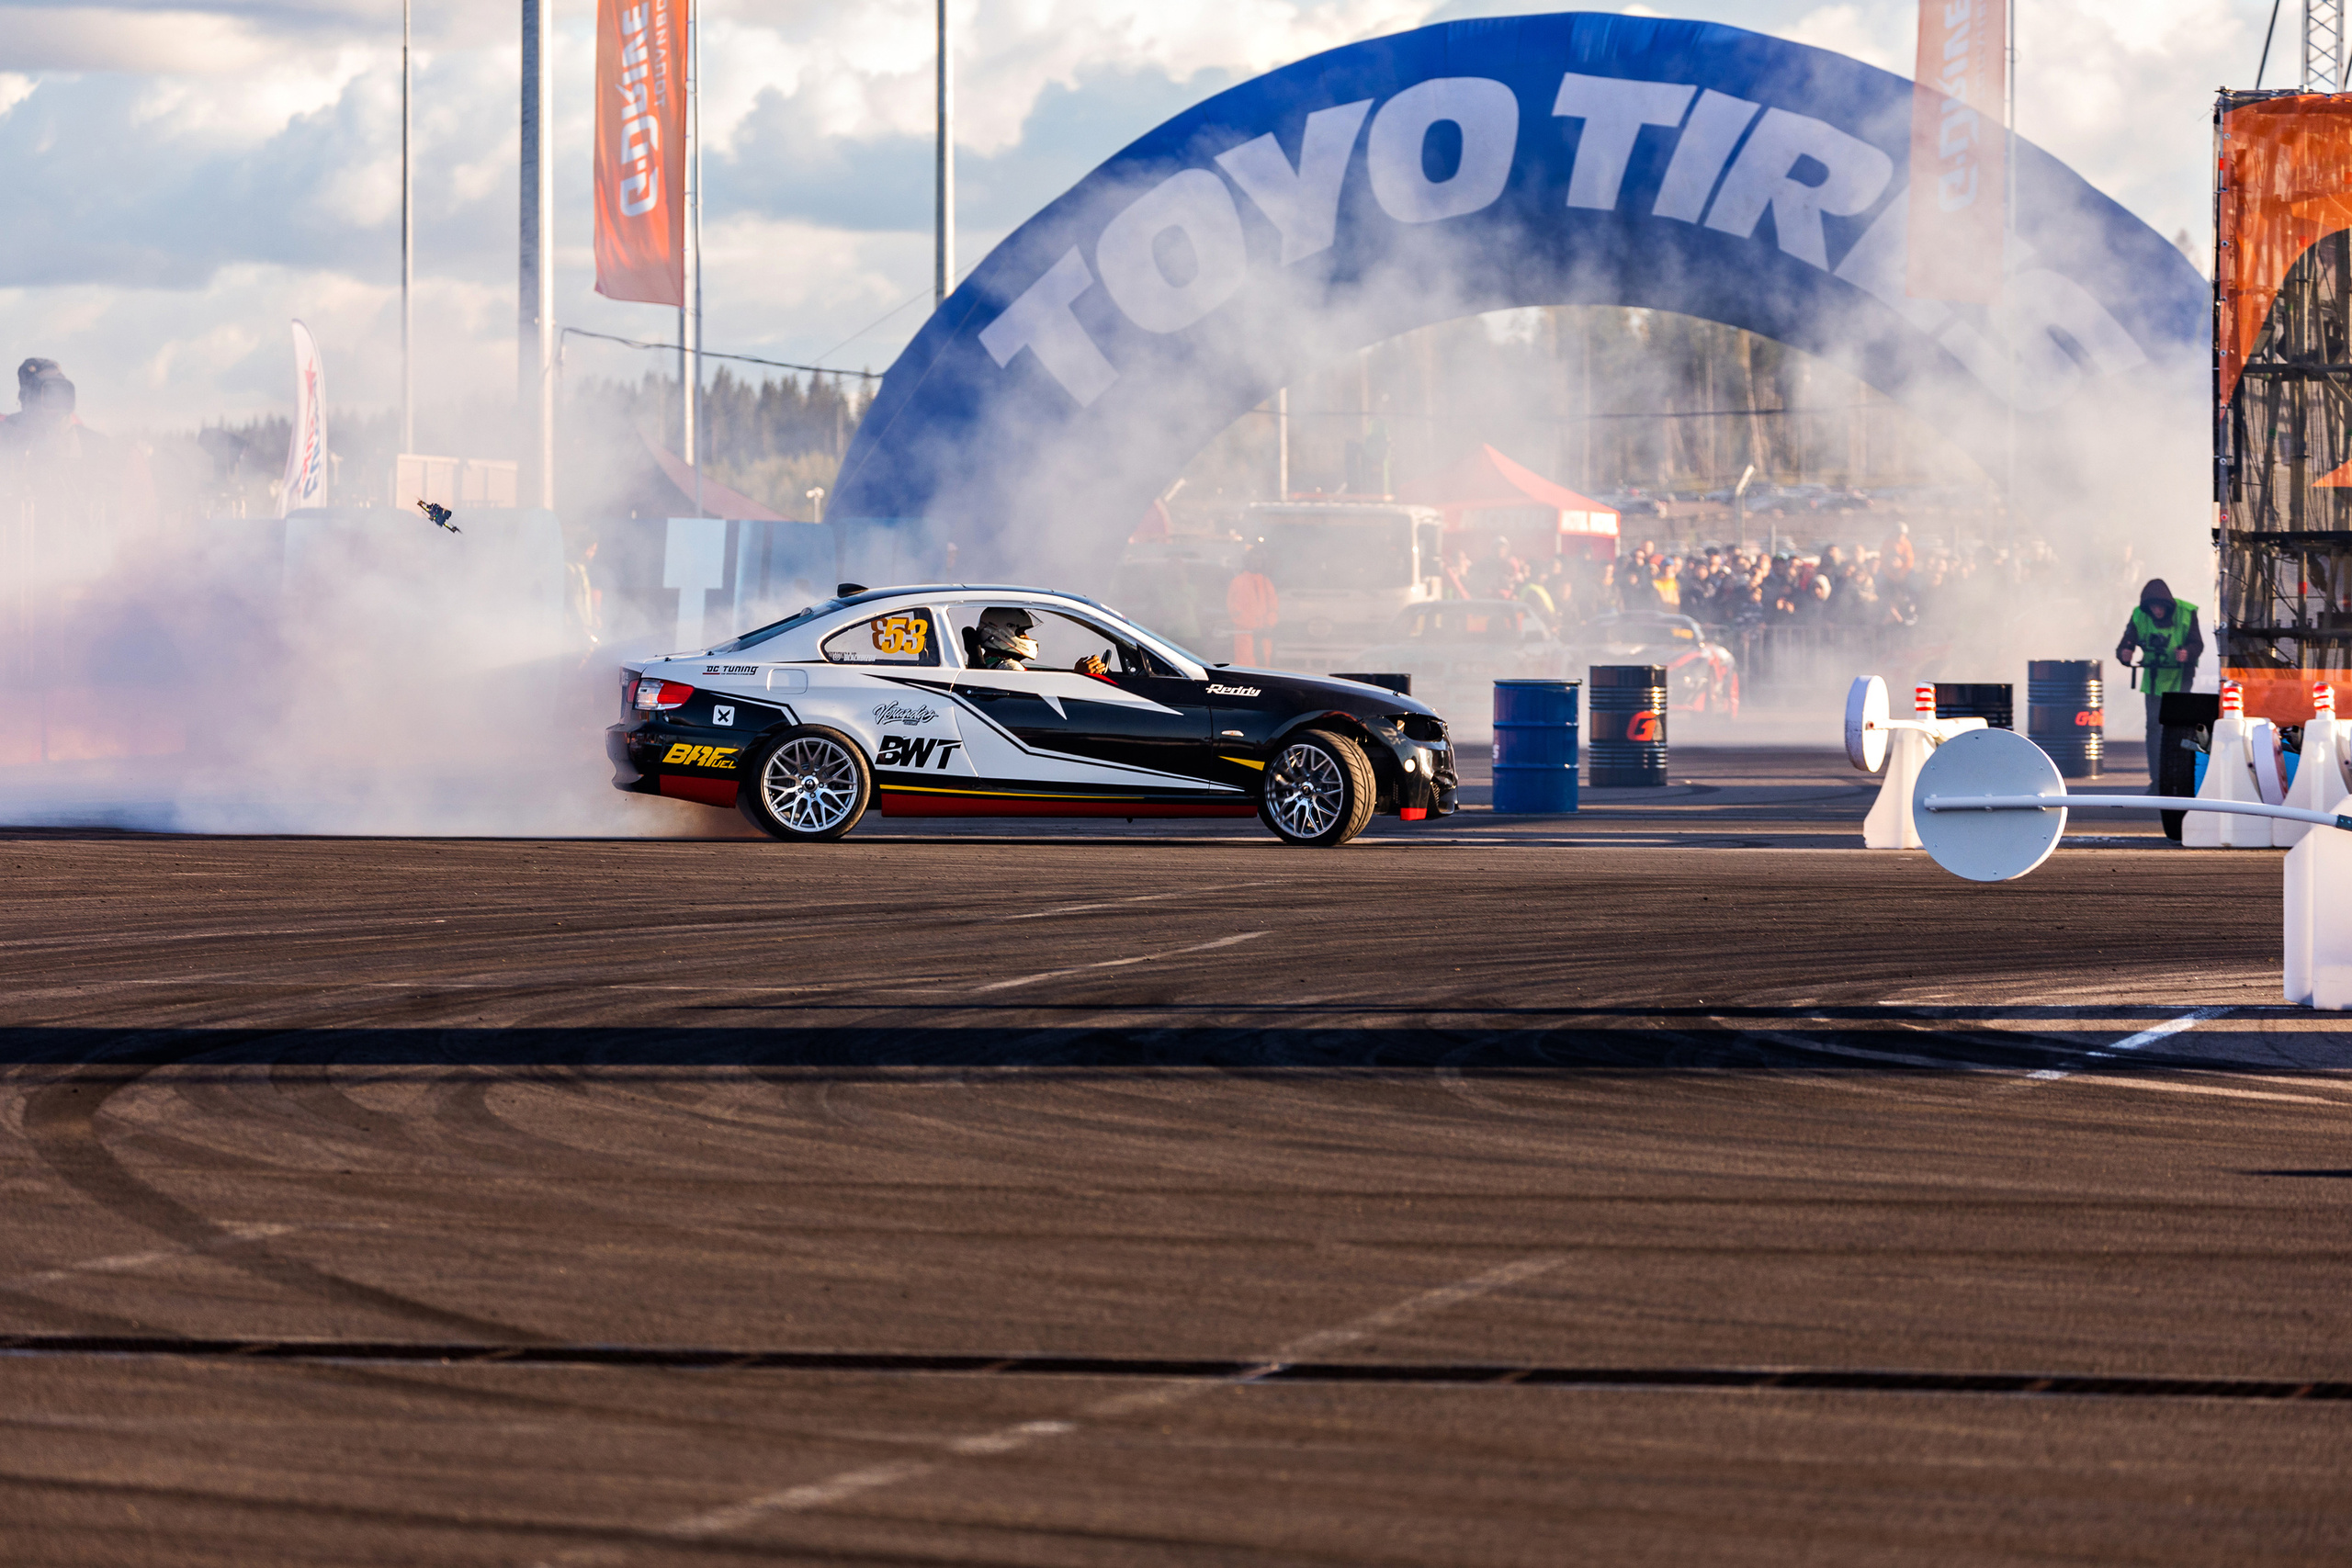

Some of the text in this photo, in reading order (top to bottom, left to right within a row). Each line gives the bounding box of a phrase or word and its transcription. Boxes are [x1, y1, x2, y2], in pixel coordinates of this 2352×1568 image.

[978, 76, 1520, 408] TOYO
[881, 618, 928, 655] 53
[1205, 683, 1261, 697] Reddy
[875, 734, 963, 770] BWT
